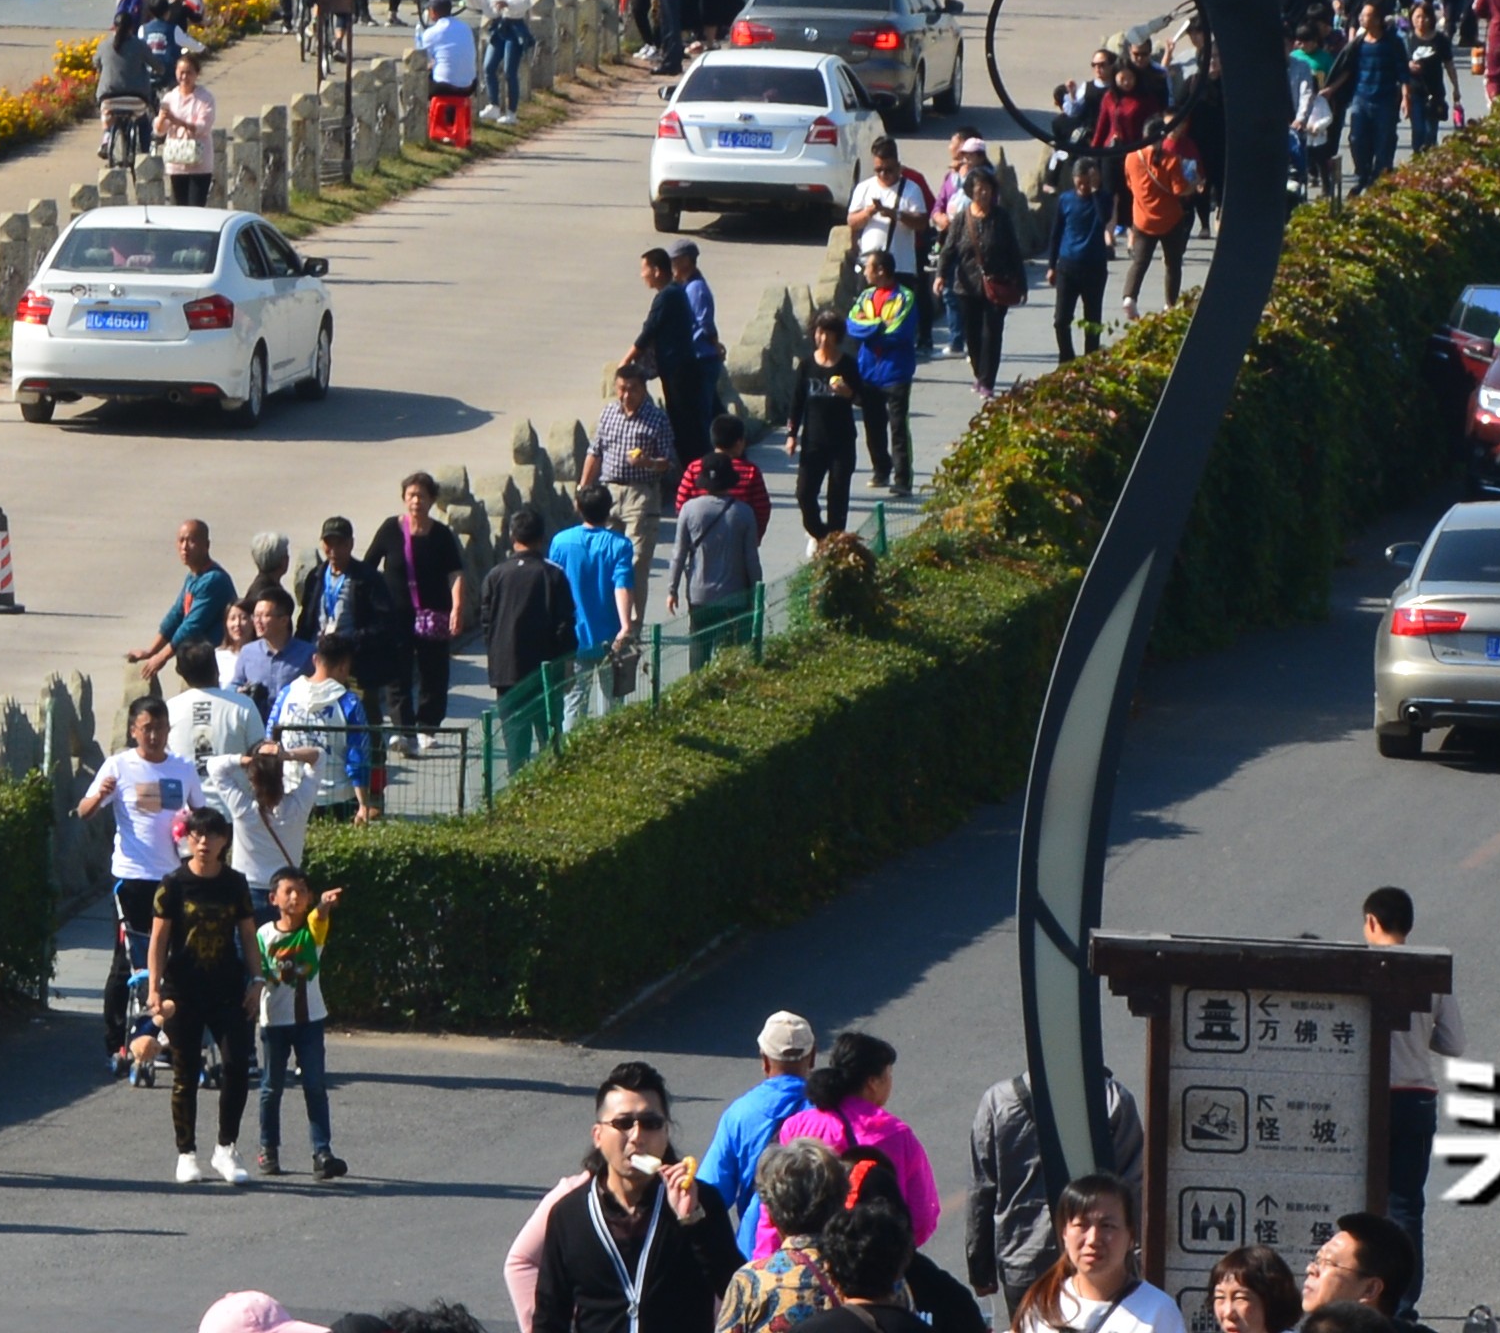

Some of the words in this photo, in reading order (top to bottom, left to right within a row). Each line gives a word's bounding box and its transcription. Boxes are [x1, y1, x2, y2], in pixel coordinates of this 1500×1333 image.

[1257, 1018, 1355, 1045] 万佛寺
[1256, 1116, 1337, 1144] 怪坡
